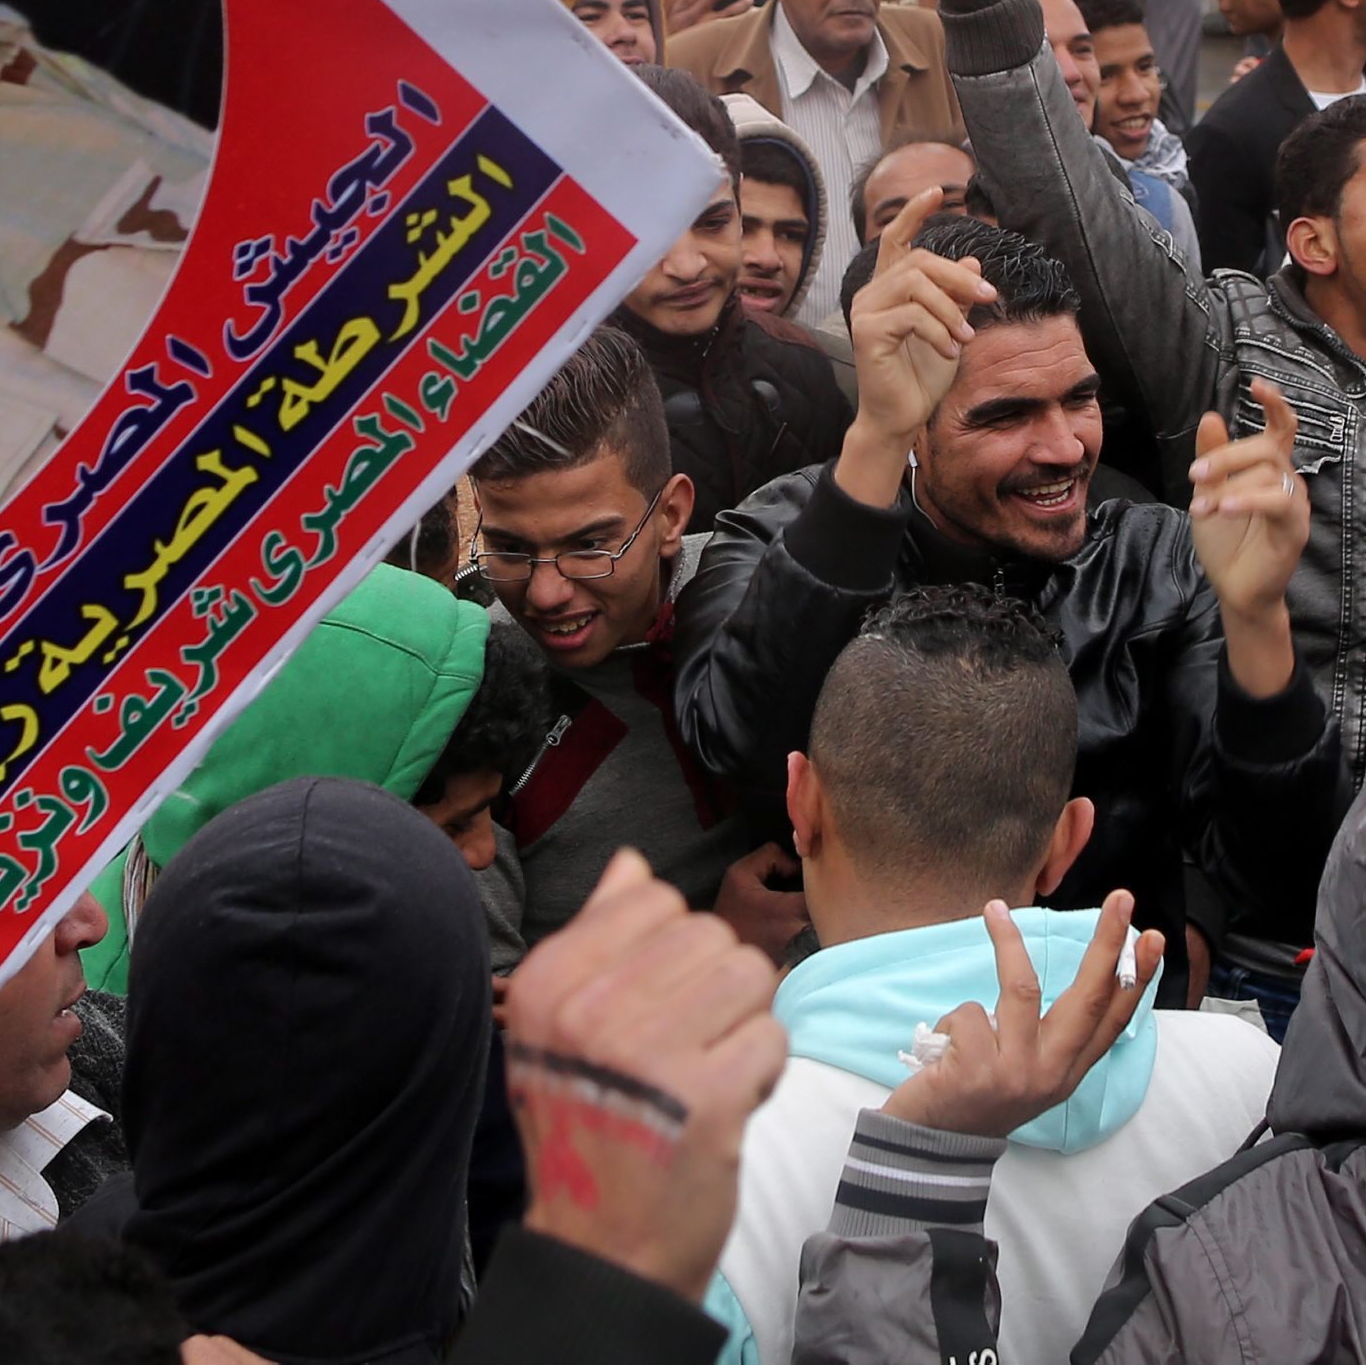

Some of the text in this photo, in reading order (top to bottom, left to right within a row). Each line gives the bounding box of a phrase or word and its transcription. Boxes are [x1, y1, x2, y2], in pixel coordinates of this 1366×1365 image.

[223, 81, 443, 362] الجيش
[249, 154, 514, 432] الشرطة
[419, 214, 587, 422] القضاء
[4, 426, 275, 696] المصرية
[87, 585, 257, 773] شريف
